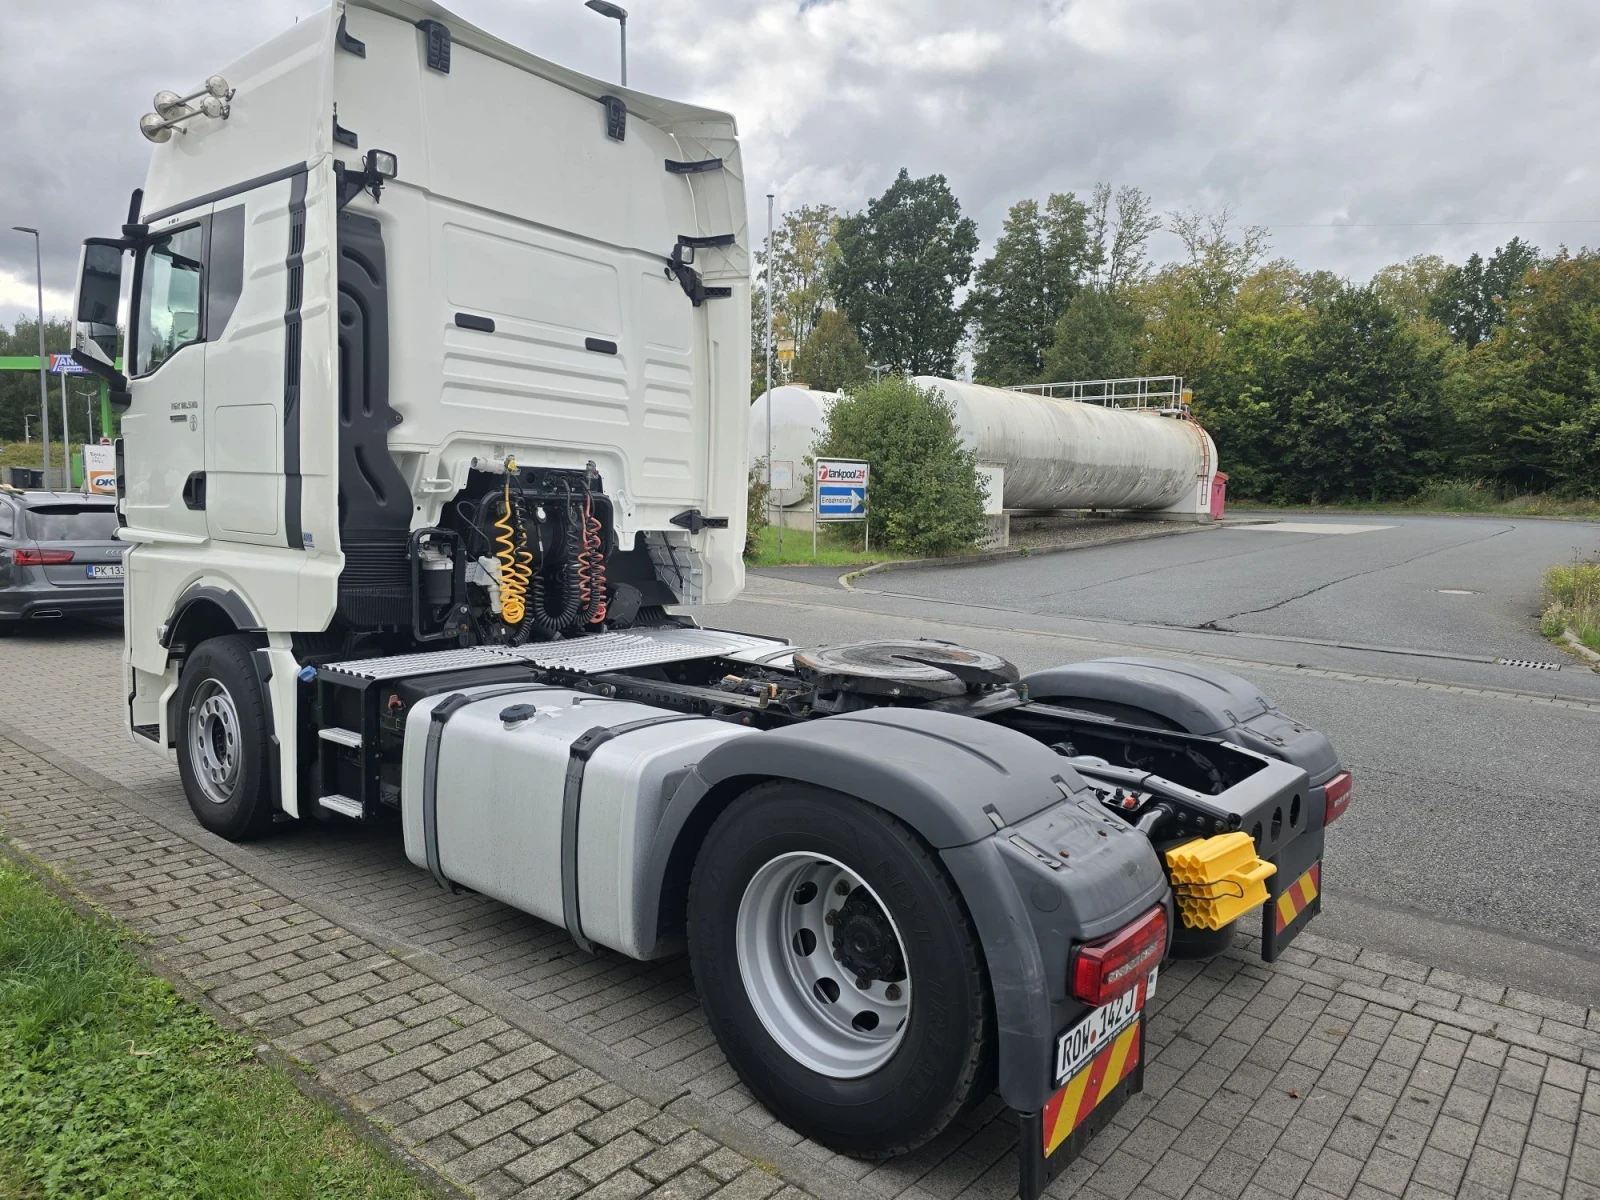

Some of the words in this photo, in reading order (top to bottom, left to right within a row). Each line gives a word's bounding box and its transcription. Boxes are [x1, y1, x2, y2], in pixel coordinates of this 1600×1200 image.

[53, 354, 77, 371] TAN
[828, 469, 866, 480] tankpool24
[94, 566, 107, 576] PK
[1061, 1020, 1091, 1071] ROW
[1099, 997, 1124, 1038] 142
